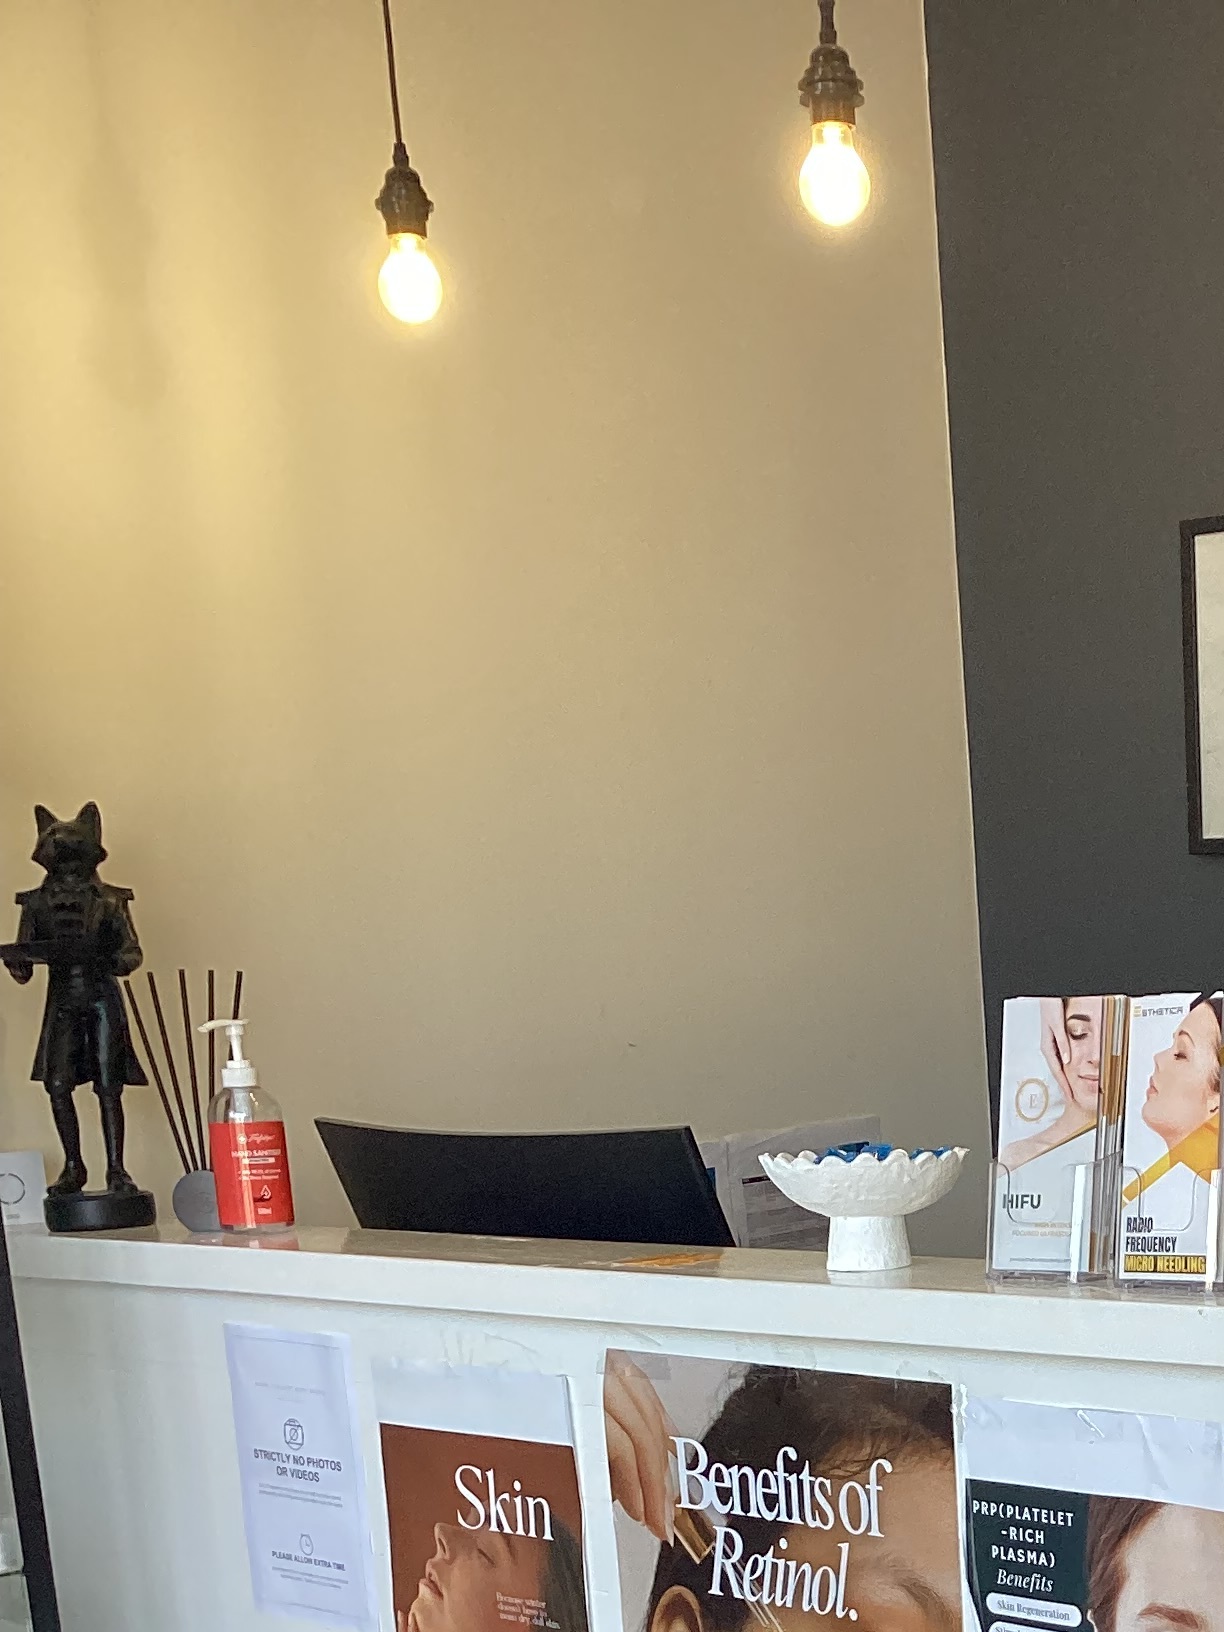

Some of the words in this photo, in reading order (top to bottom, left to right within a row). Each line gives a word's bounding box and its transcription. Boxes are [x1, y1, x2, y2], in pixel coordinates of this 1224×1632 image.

[1003, 1194, 1041, 1209] HIFU
[1126, 1217, 1153, 1233] RADIO
[1126, 1237, 1177, 1253] FREQUENCY
[1125, 1256, 1154, 1271] MICRO
[1157, 1256, 1205, 1273] NEEDLING
[254, 1449, 291, 1464] STRICTLY
[293, 1455, 305, 1466] NO
[307, 1457, 342, 1471] PHOTOS
[276, 1466, 288, 1477] OR
[289, 1468, 319, 1482] VIDEOS
[669, 1435, 833, 1530] Benefits
[841, 1458, 892, 1537] of
[455, 1464, 554, 1541] Skin
[973, 1500, 1073, 1526] PRP(PLATELET
[1001, 1526, 1044, 1544] -RICH
[991, 1545, 1055, 1568] PLASMA)
[708, 1526, 859, 1622] Retinol.
[997, 1569, 1053, 1593] Benefits
[997, 1600, 1015, 1612] Skin
[1017, 1603, 1070, 1620] Regeneration
